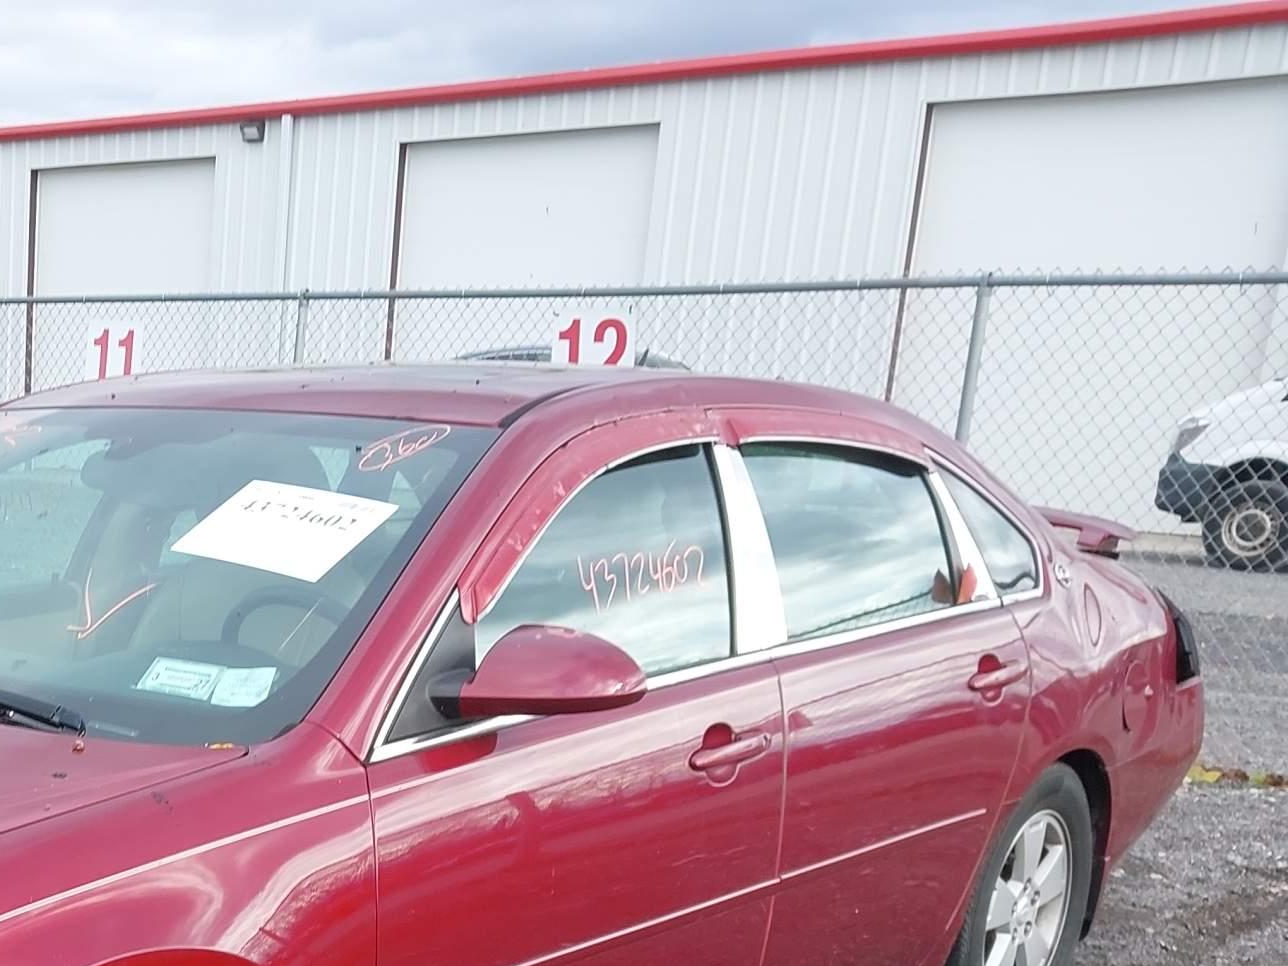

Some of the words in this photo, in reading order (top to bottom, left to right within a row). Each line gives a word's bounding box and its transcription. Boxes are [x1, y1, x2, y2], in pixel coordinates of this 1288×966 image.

[94, 329, 134, 380] 11
[558, 318, 627, 366] 12
[576, 538, 708, 616] 43724602
